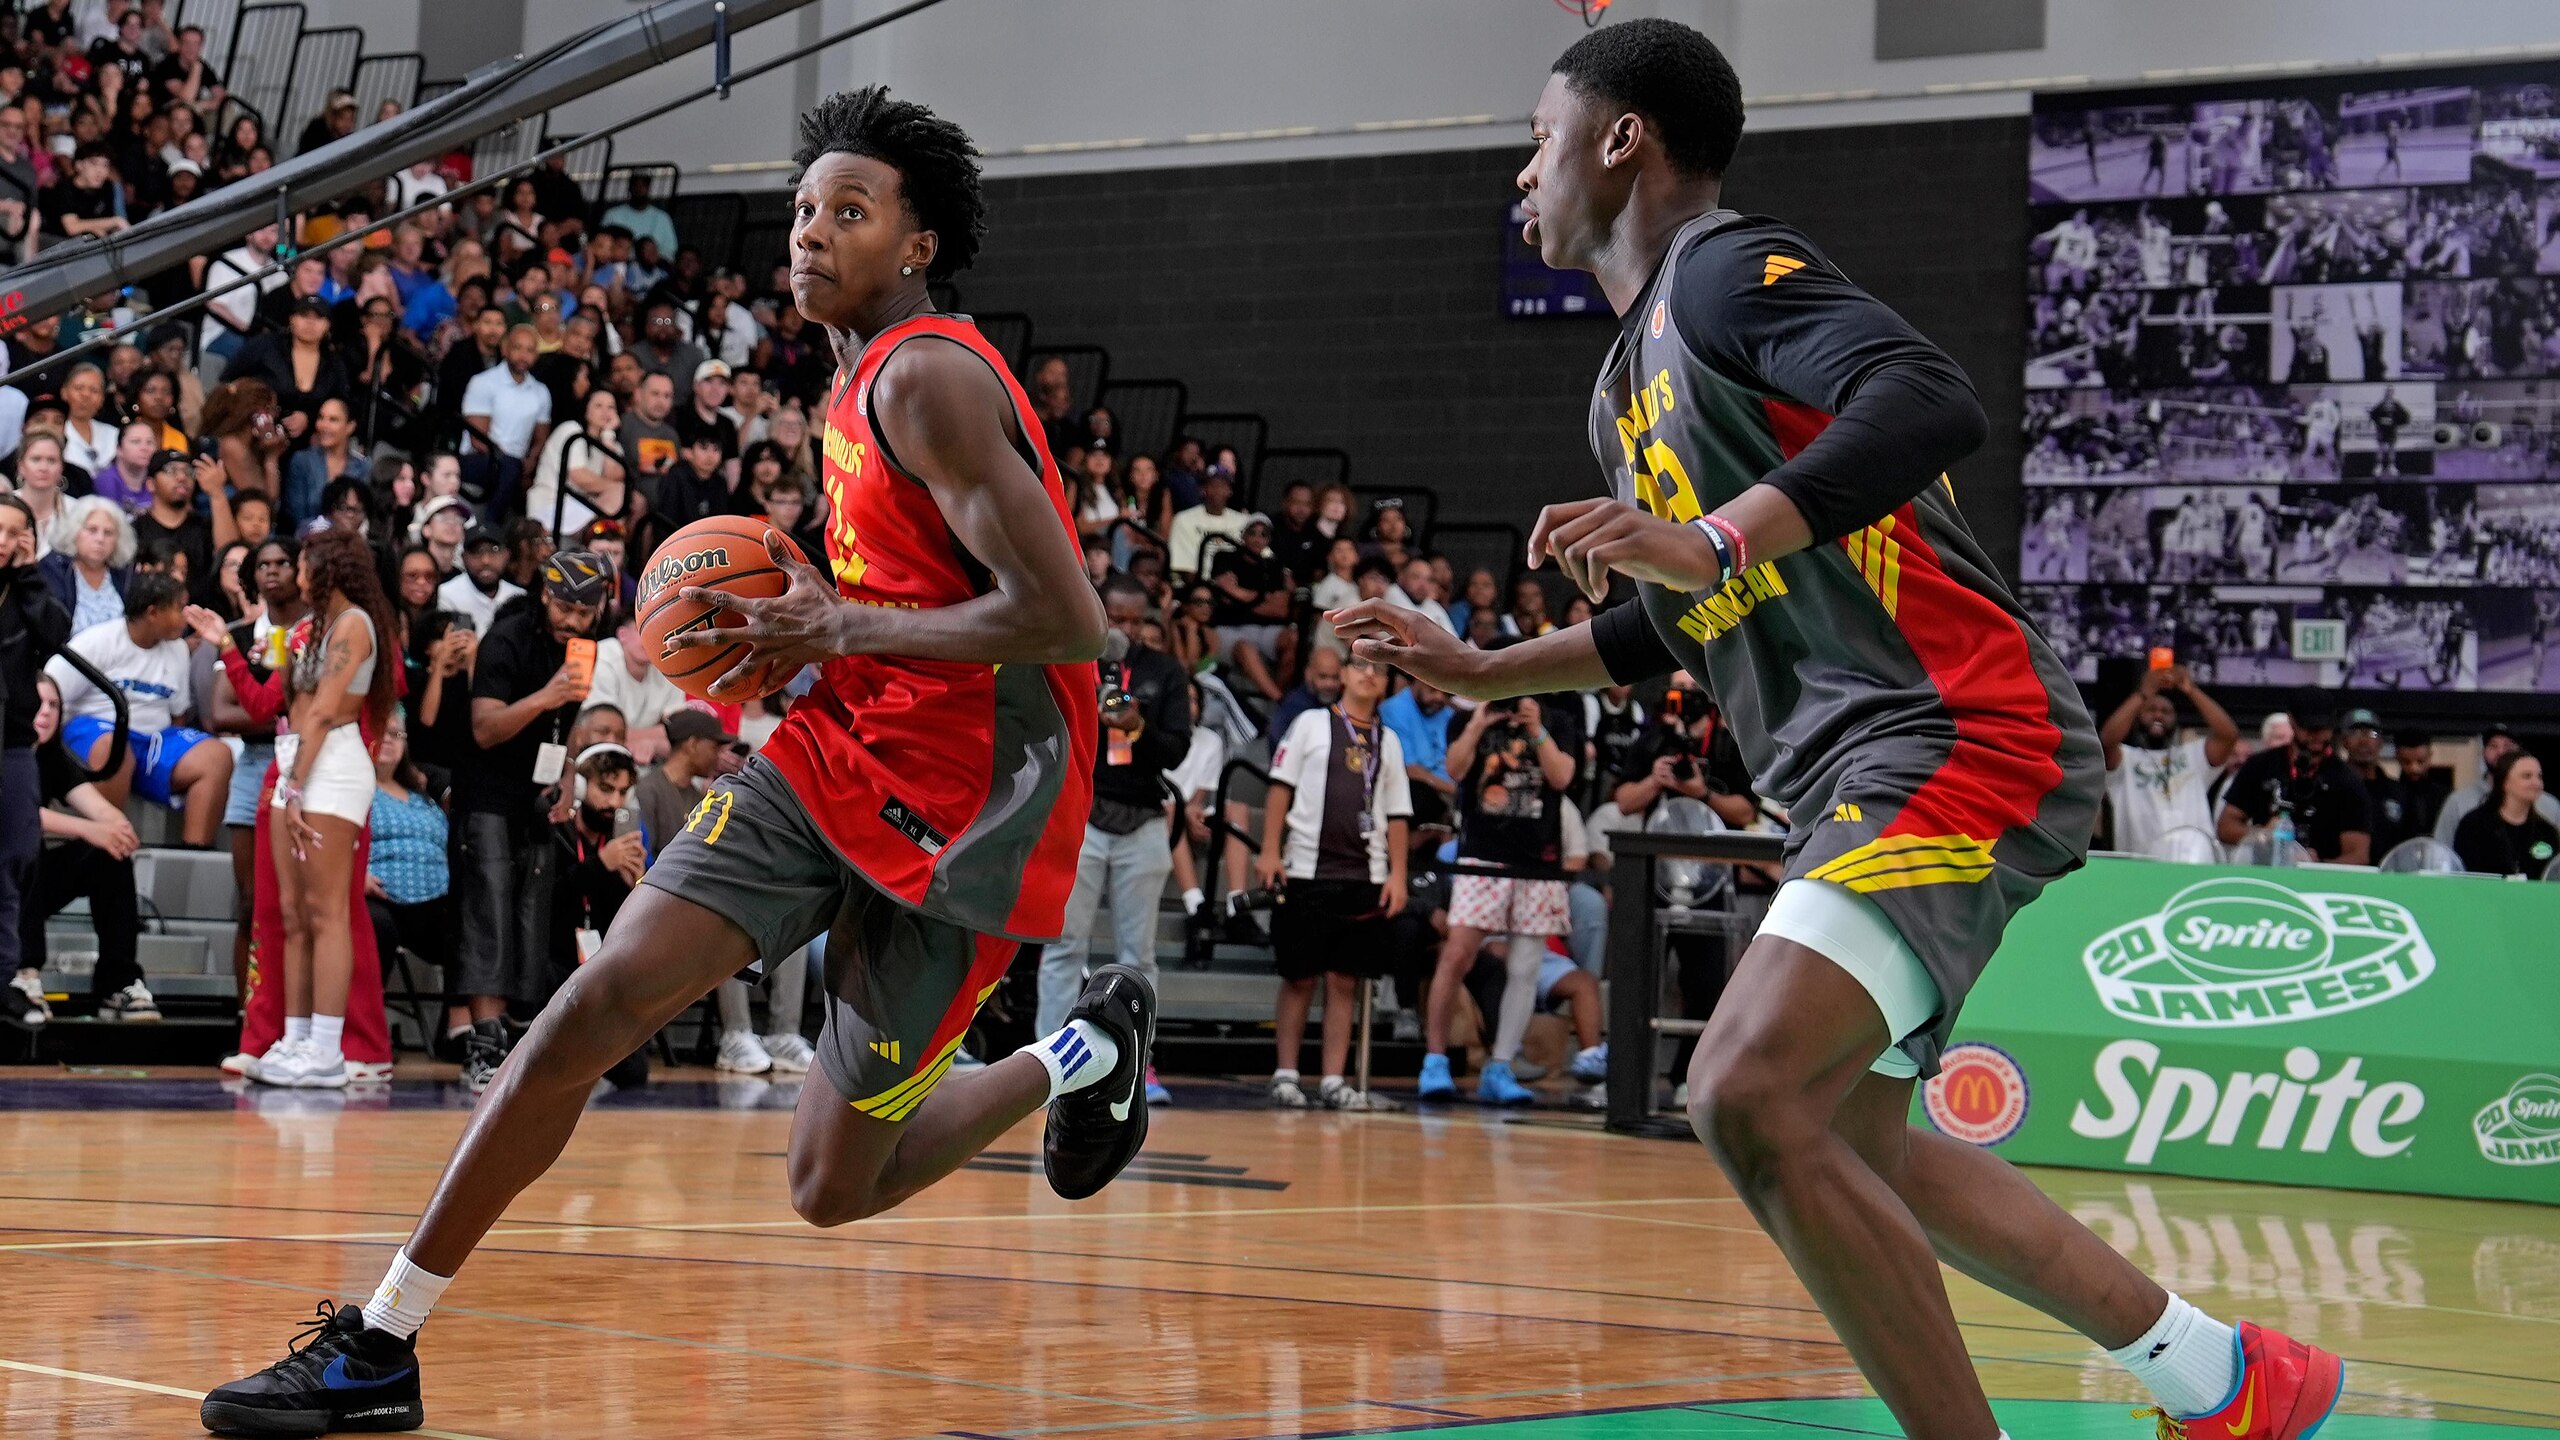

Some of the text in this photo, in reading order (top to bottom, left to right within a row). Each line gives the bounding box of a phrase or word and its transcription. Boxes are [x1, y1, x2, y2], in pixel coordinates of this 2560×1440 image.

[636, 547, 731, 612] Wilson
[2302, 625, 2335, 653] EXIT
[909, 825, 917, 836] XL
[2092, 900, 2410, 979] 20 26
[2178, 916, 2313, 951] Sprite
[2111, 938, 2420, 1021] JAMFEST
[2070, 1038, 2426, 1165] Sprite
[373, 1406, 388, 1416] BOOK
